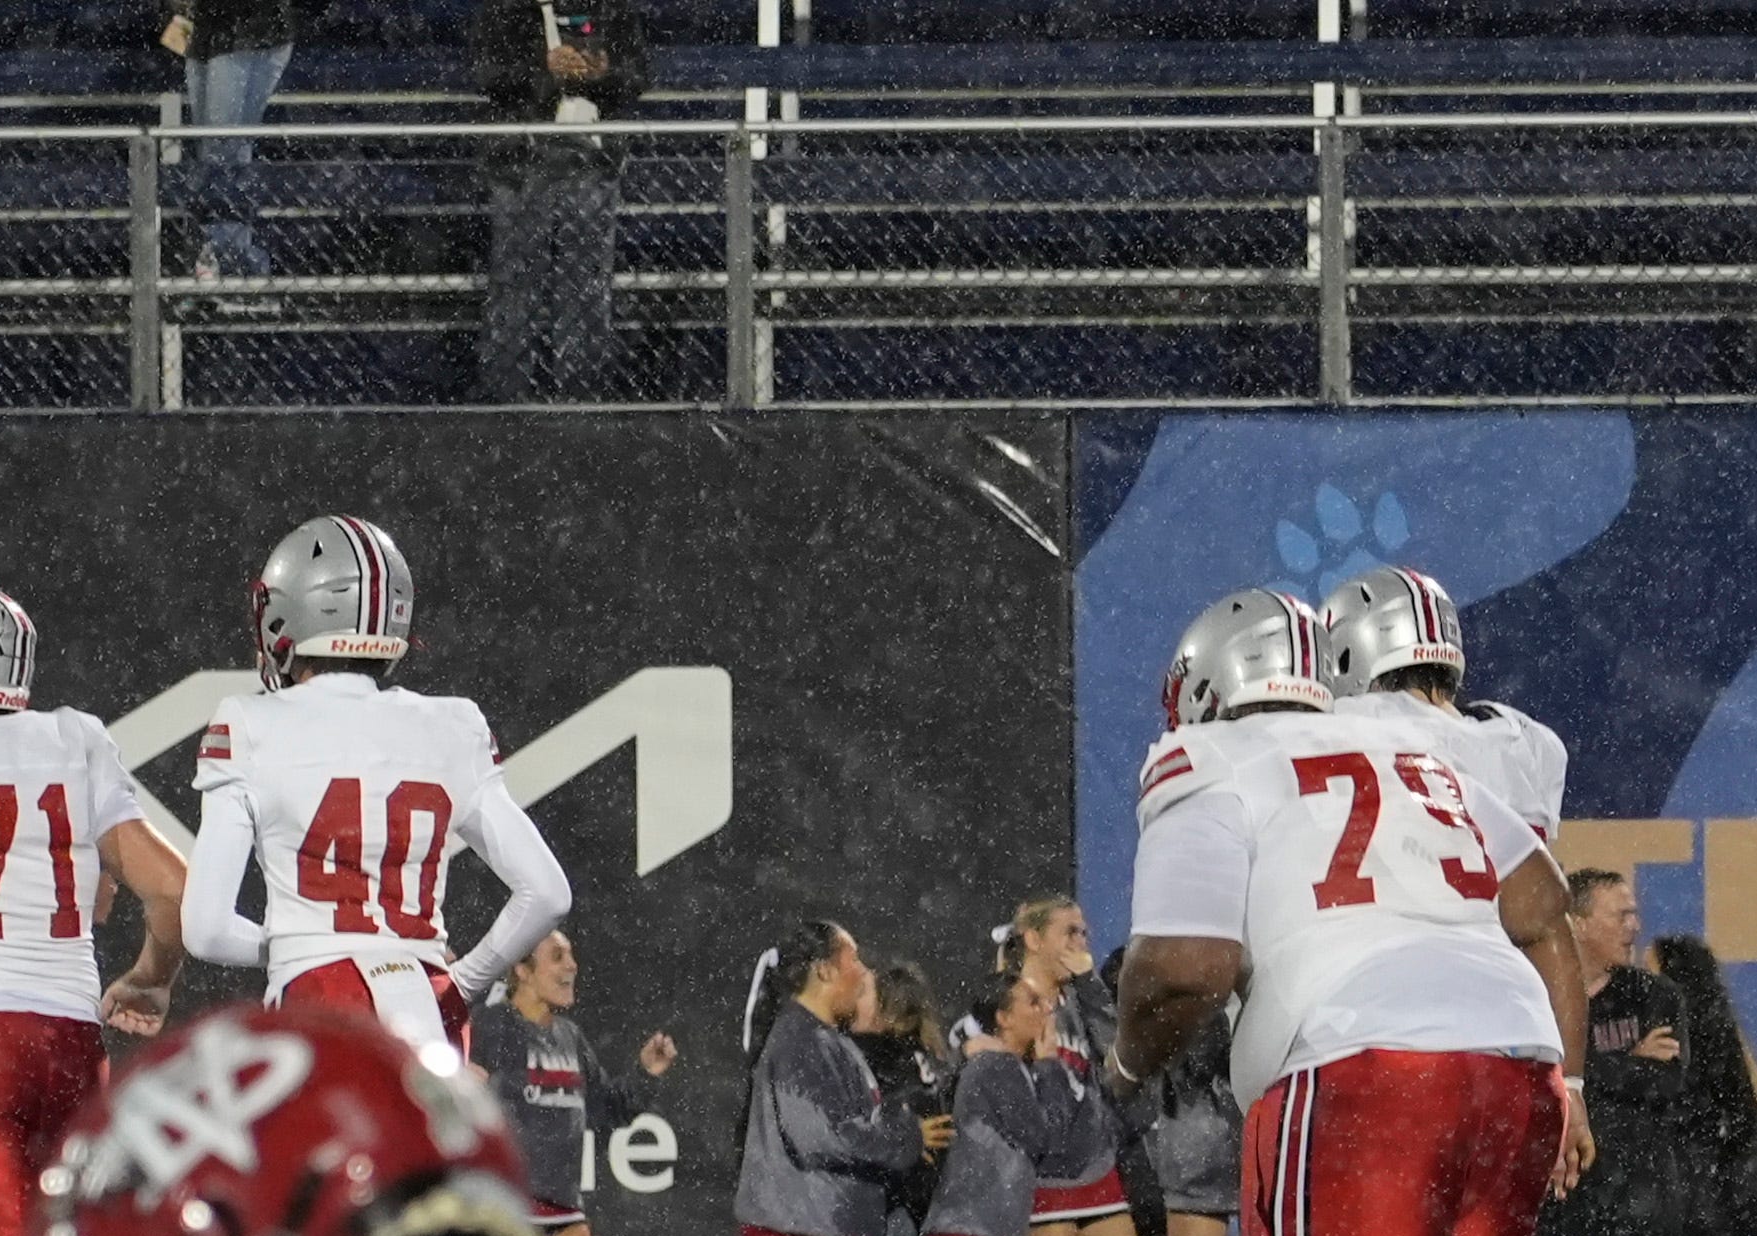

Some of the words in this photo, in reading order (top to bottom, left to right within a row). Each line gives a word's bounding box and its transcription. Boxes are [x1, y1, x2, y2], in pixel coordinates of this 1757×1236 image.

[330, 640, 401, 655] Riddell
[296, 777, 453, 941] 40
[1291, 751, 1501, 911] 79
